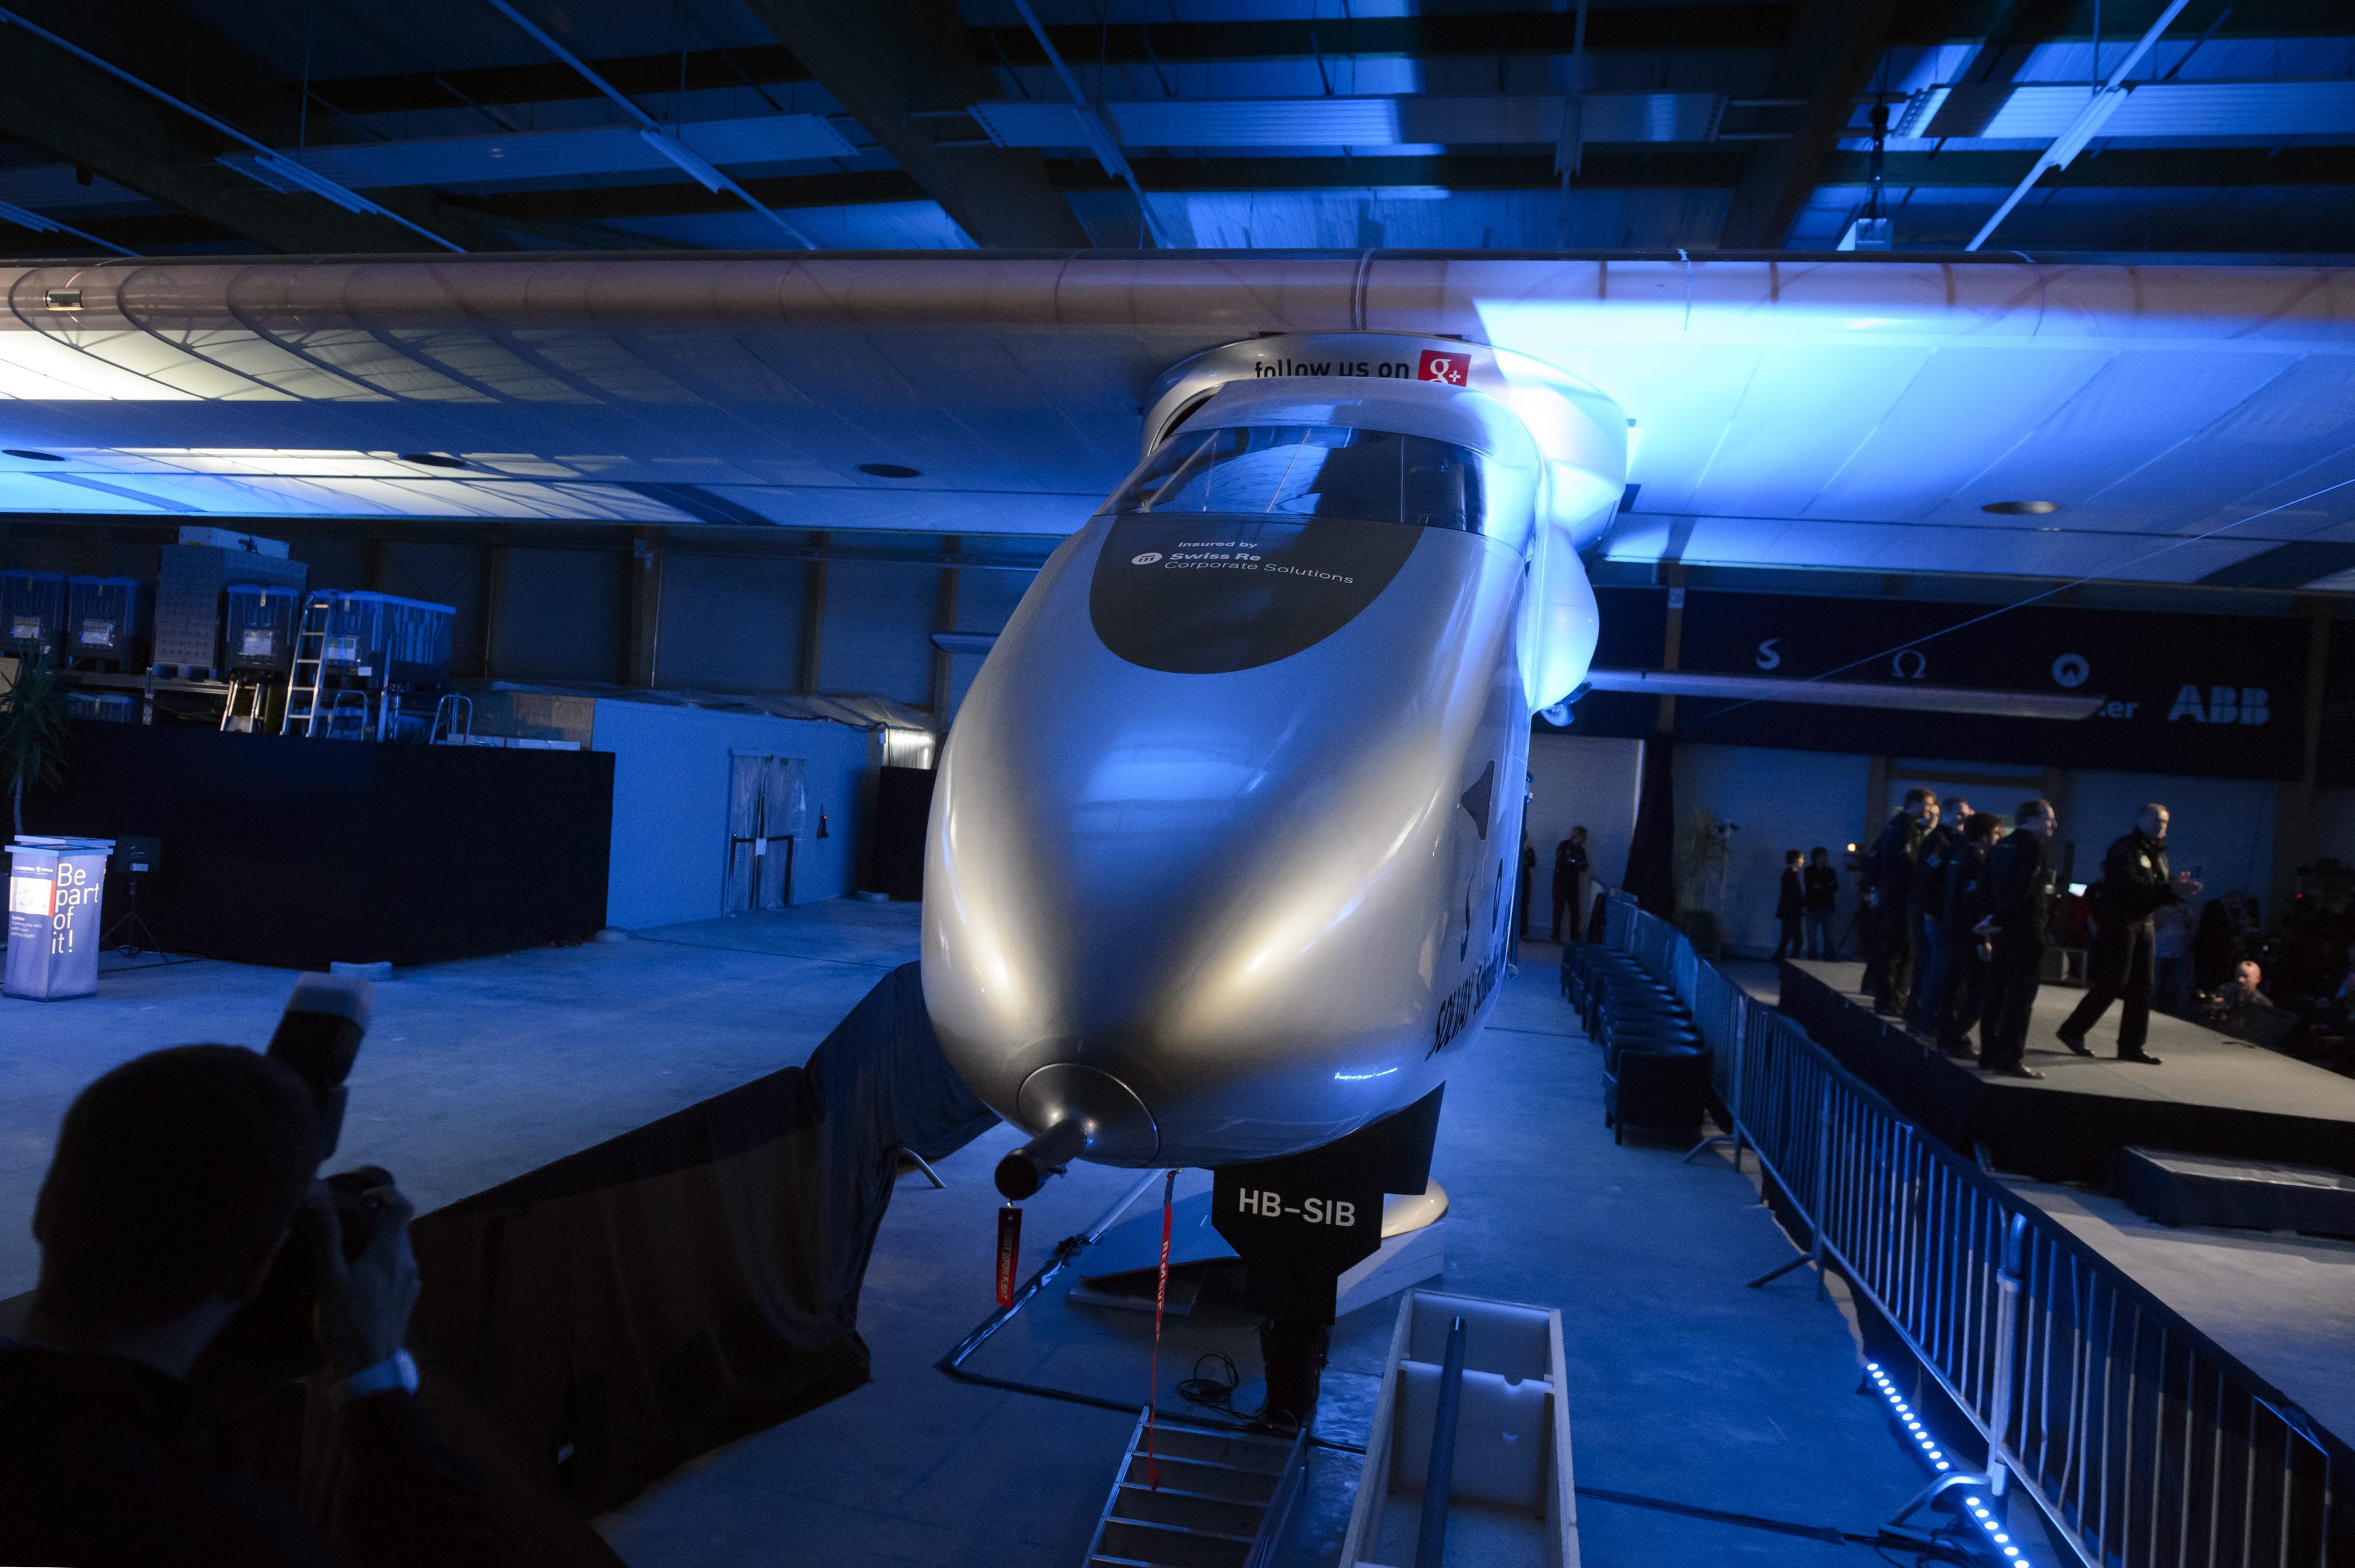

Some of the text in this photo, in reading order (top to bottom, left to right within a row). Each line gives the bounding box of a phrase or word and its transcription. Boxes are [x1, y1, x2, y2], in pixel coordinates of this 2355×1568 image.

[1255, 359, 1331, 377] follow
[1339, 362, 1369, 377] us
[1378, 362, 1409, 378] on
[1235, 553, 1261, 561] Re
[1164, 561, 1353, 584] Corporate Solutions
[2166, 684, 2271, 726] ABB
[57, 862, 86, 887] Be
[55, 883, 99, 913] part
[53, 906, 74, 930] of
[52, 930, 73, 954] it!
[1239, 1187, 1356, 1226] HB-SIB
